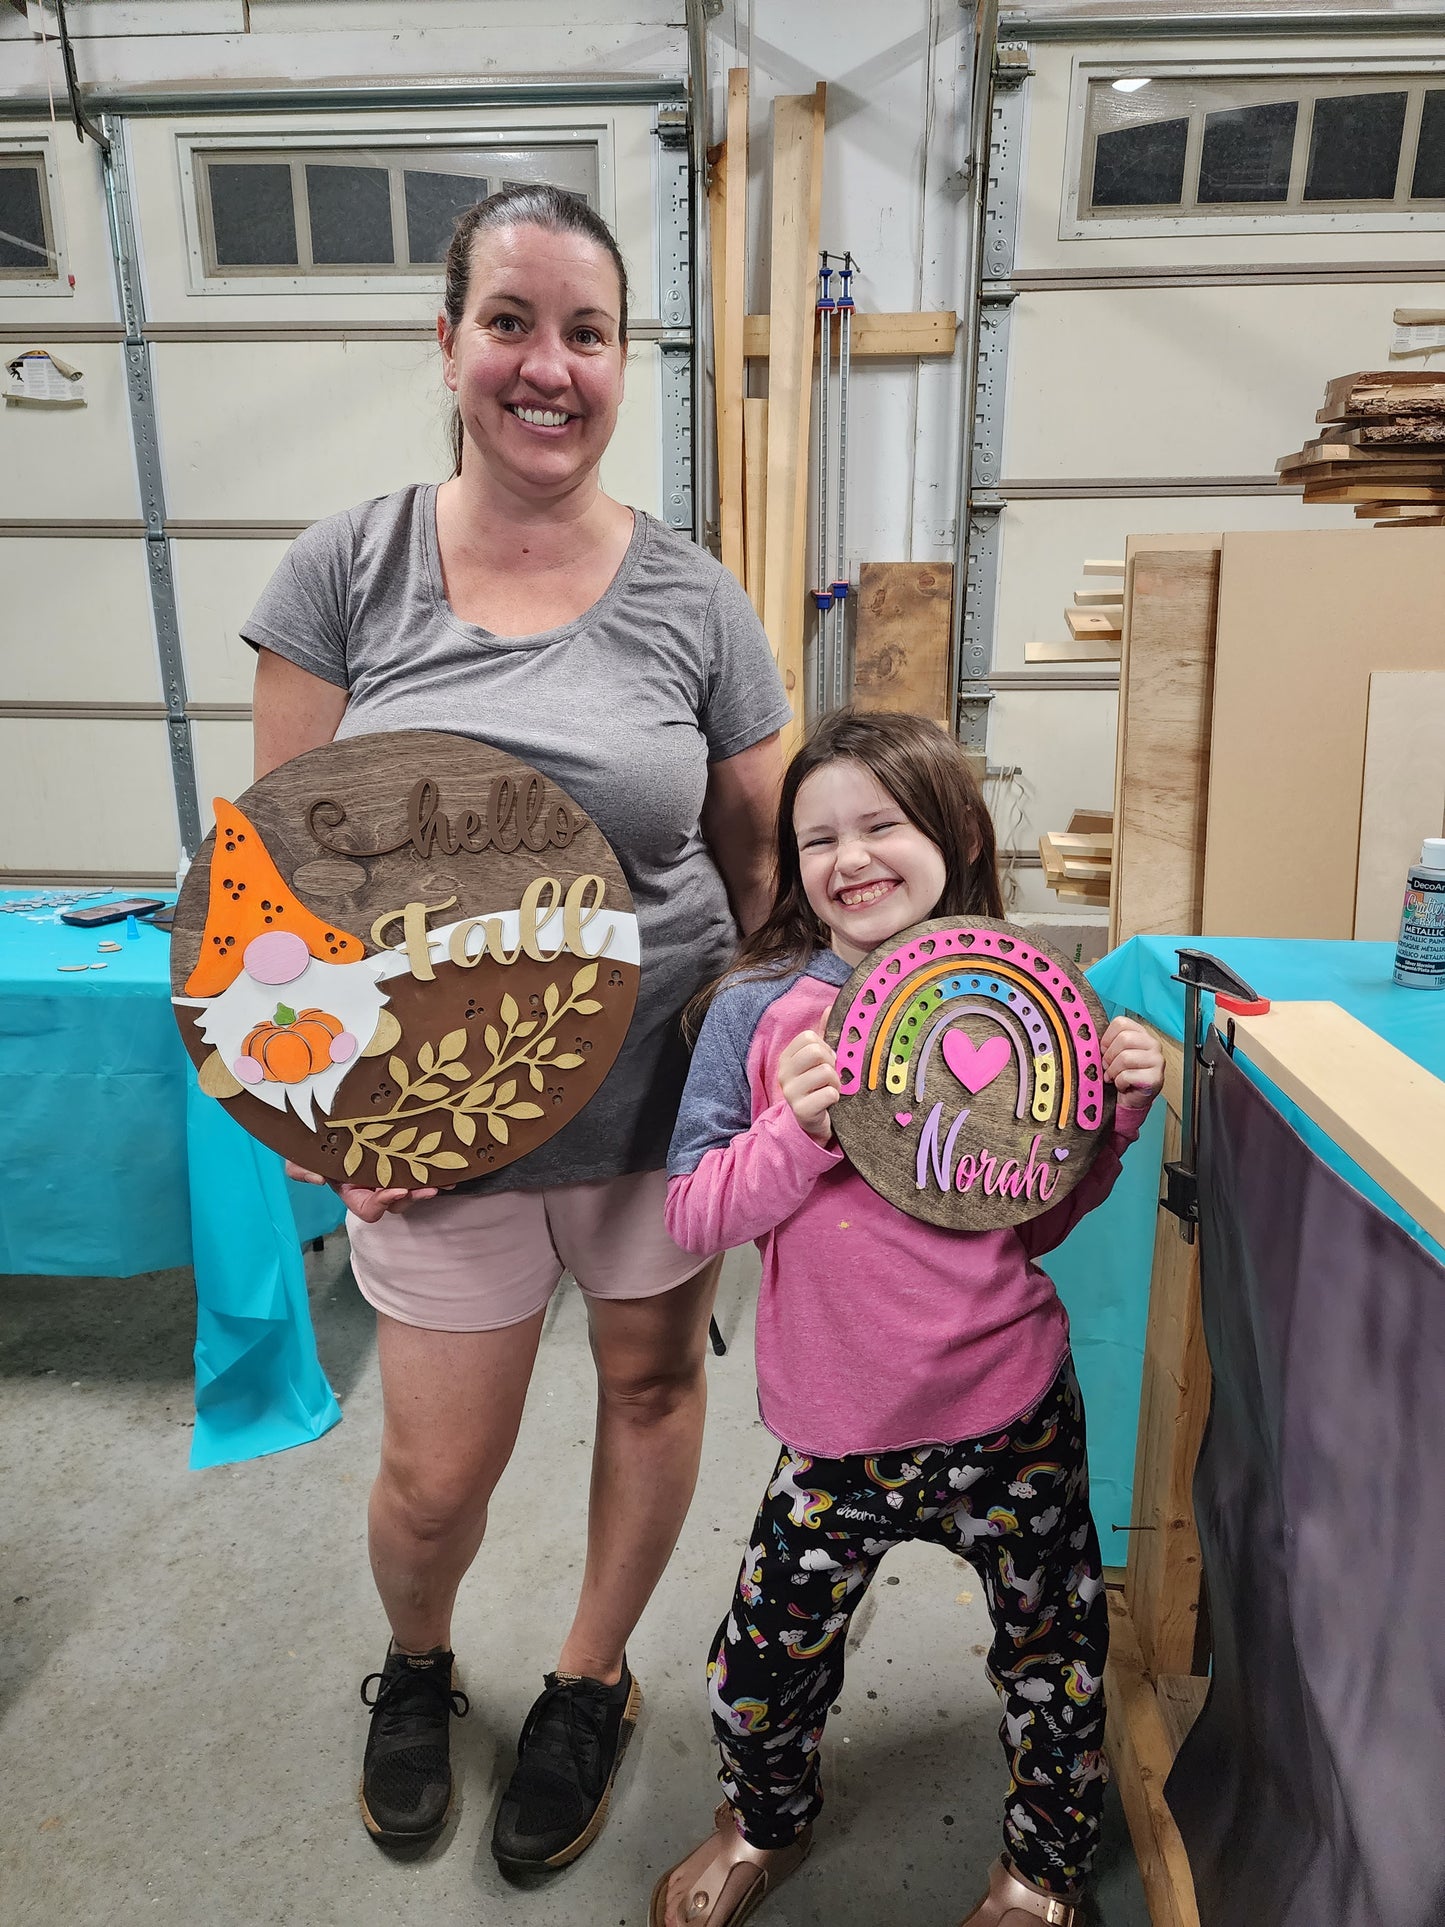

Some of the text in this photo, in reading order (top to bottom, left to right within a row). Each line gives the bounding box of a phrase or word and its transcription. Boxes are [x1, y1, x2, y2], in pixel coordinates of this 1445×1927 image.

[137, 392, 145, 402] 2
[305, 774, 586, 858] hello
[370, 874, 615, 982] Fall
[1405, 925, 1445, 936] METALLIC
[916, 1102, 1061, 1201] Norah
